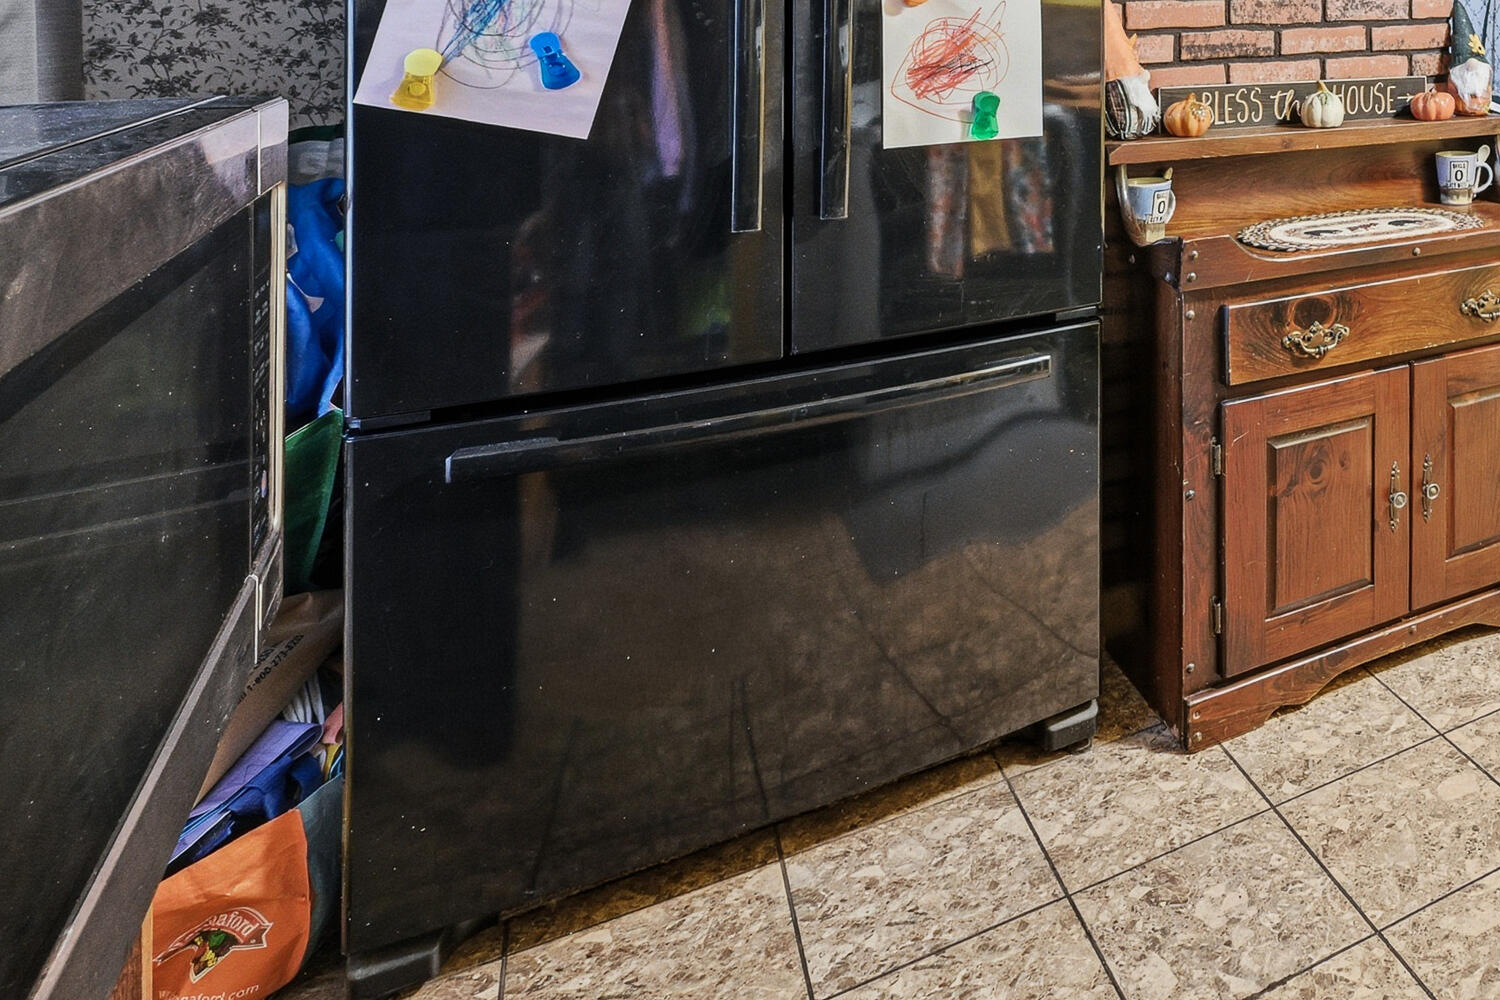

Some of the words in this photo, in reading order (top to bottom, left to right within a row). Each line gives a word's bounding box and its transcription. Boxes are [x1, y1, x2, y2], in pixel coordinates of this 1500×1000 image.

[1202, 87, 1263, 125] BLESS
[1270, 88, 1301, 121] th
[1333, 82, 1397, 116] HOUSE
